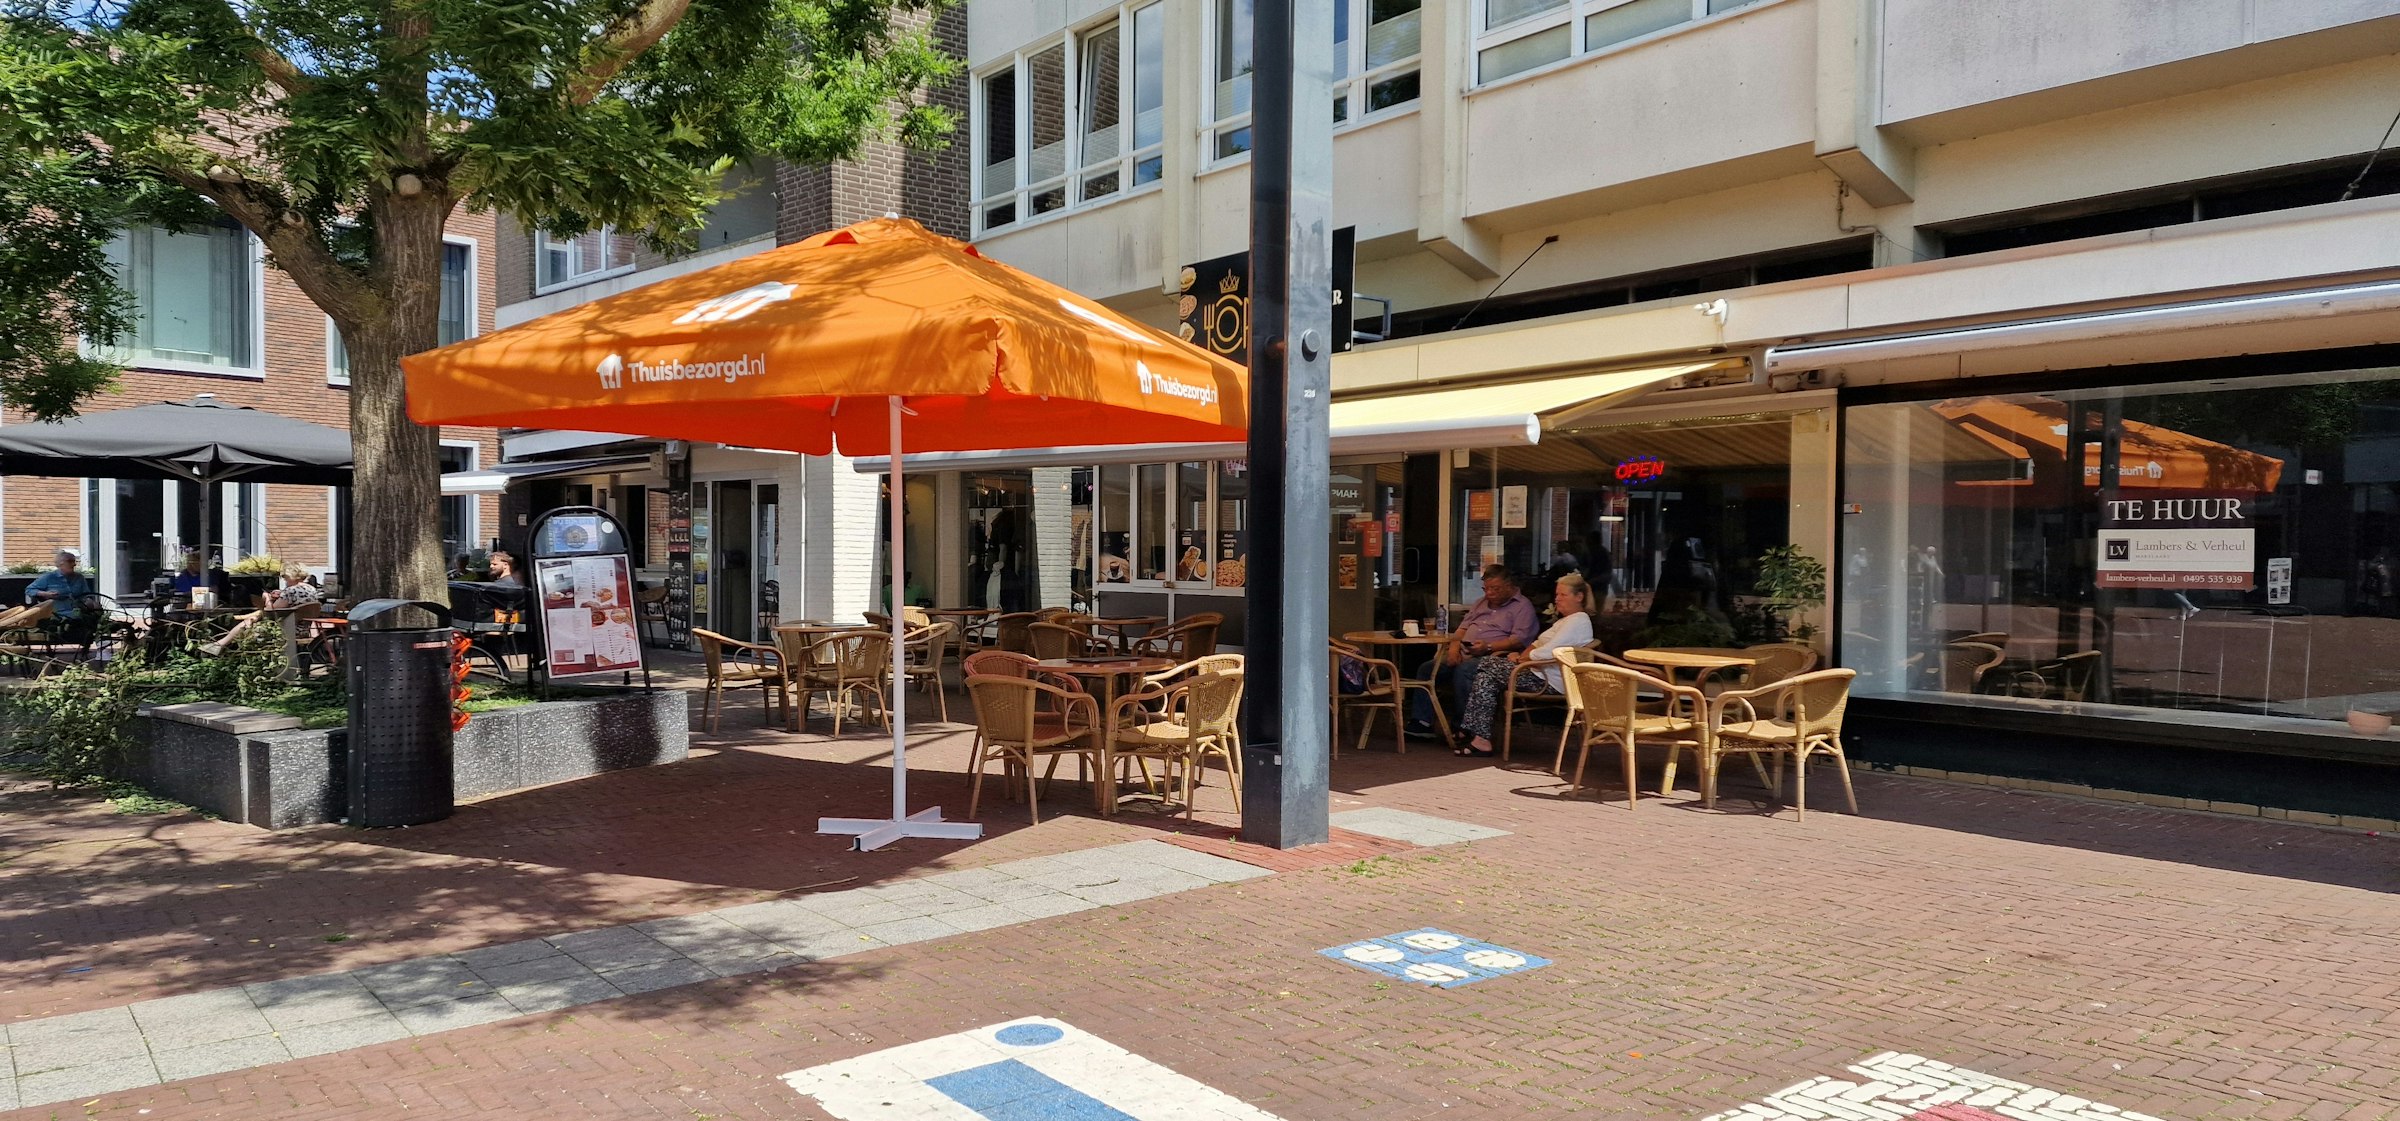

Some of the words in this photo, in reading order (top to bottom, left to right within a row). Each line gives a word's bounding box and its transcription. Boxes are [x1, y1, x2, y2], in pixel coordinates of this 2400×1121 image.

[627, 353, 765, 383] Thuisbezorgd.nl
[1152, 373, 1217, 406] Thuisbezorgd.nl
[1615, 461, 1665, 479] OPEN
[2108, 500, 2144, 521] TE
[2152, 498, 2246, 520] HUUR
[2109, 545, 2127, 556] LV
[2135, 540, 2182, 551] Lambers
[2185, 540, 2198, 551] &
[2202, 540, 2246, 551] Verheul
[2106, 573, 2176, 583] lambers-verheul.nl
[2183, 575, 2205, 583] 0495
[2208, 575, 2224, 583] 535
[2226, 575, 2243, 584] 939
